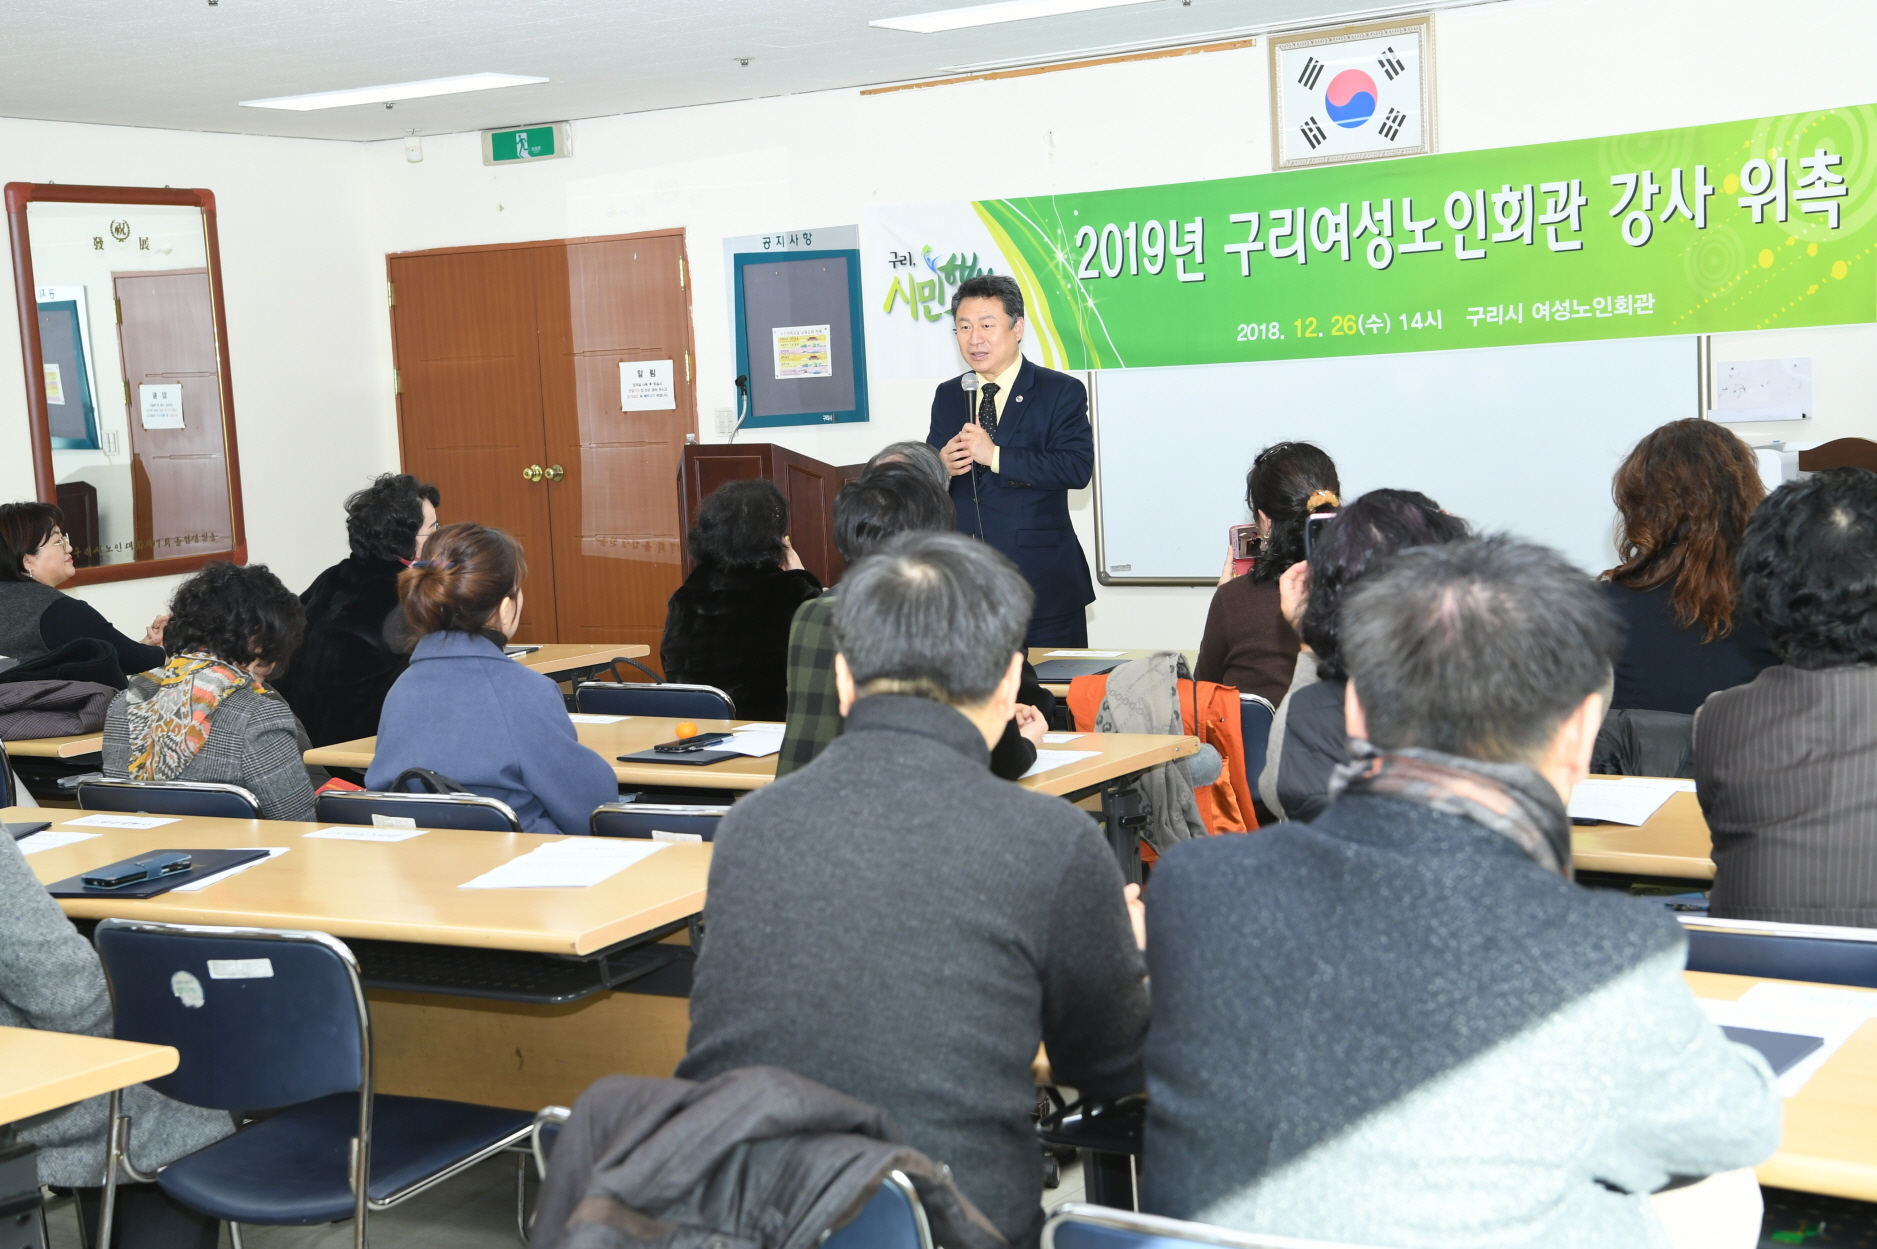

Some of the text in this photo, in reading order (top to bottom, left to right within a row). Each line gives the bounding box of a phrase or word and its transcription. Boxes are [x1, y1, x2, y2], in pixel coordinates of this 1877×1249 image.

[1076, 148, 1848, 283] 2019년 구리여성노인회관 강사 위촉
[762, 232, 813, 250] 공지사항
[888, 251, 916, 269] 구리,
[1237, 293, 1655, 341] 2018. 12. 26(수) 14시 구리시 여성노인회관
